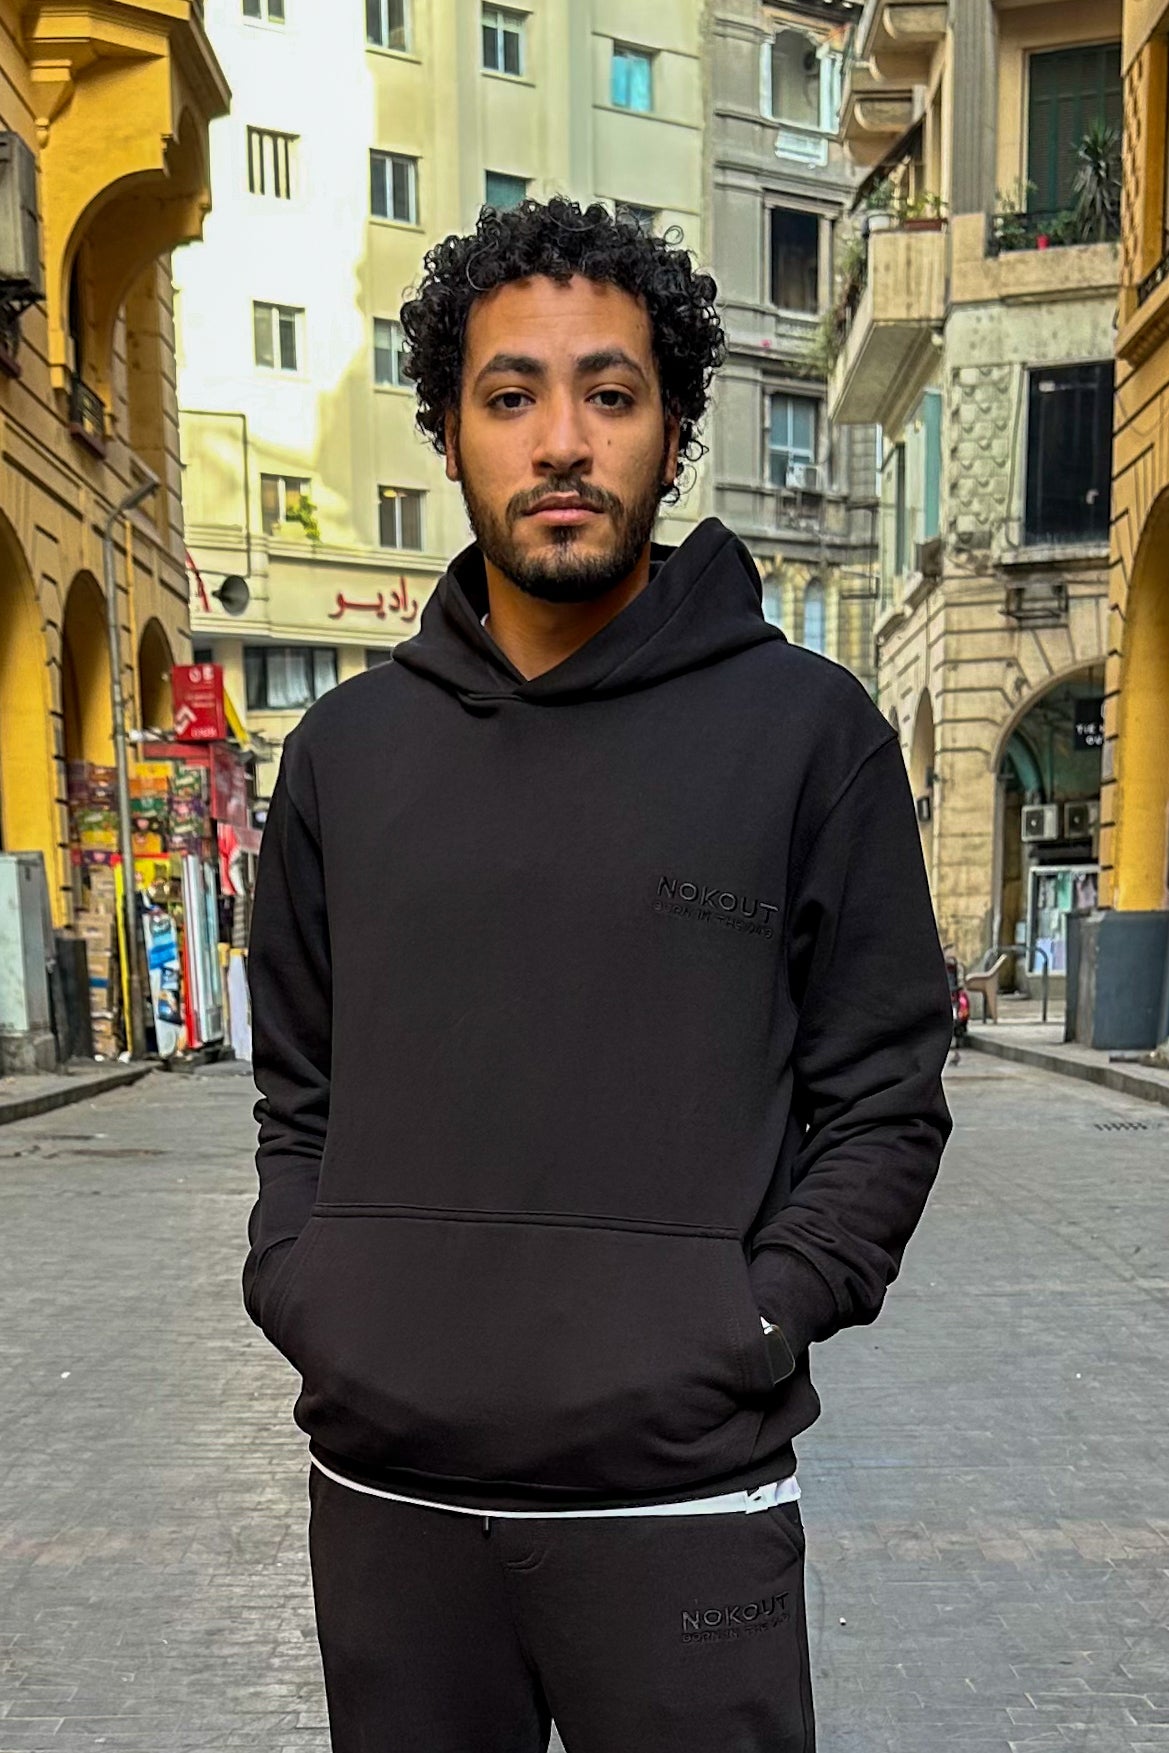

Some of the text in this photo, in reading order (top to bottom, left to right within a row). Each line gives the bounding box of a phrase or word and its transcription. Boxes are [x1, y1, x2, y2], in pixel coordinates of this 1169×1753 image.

[328, 575, 418, 624] راديو
[656, 876, 779, 924] NOKOUT
[681, 1591, 789, 1632] NOKOUT
